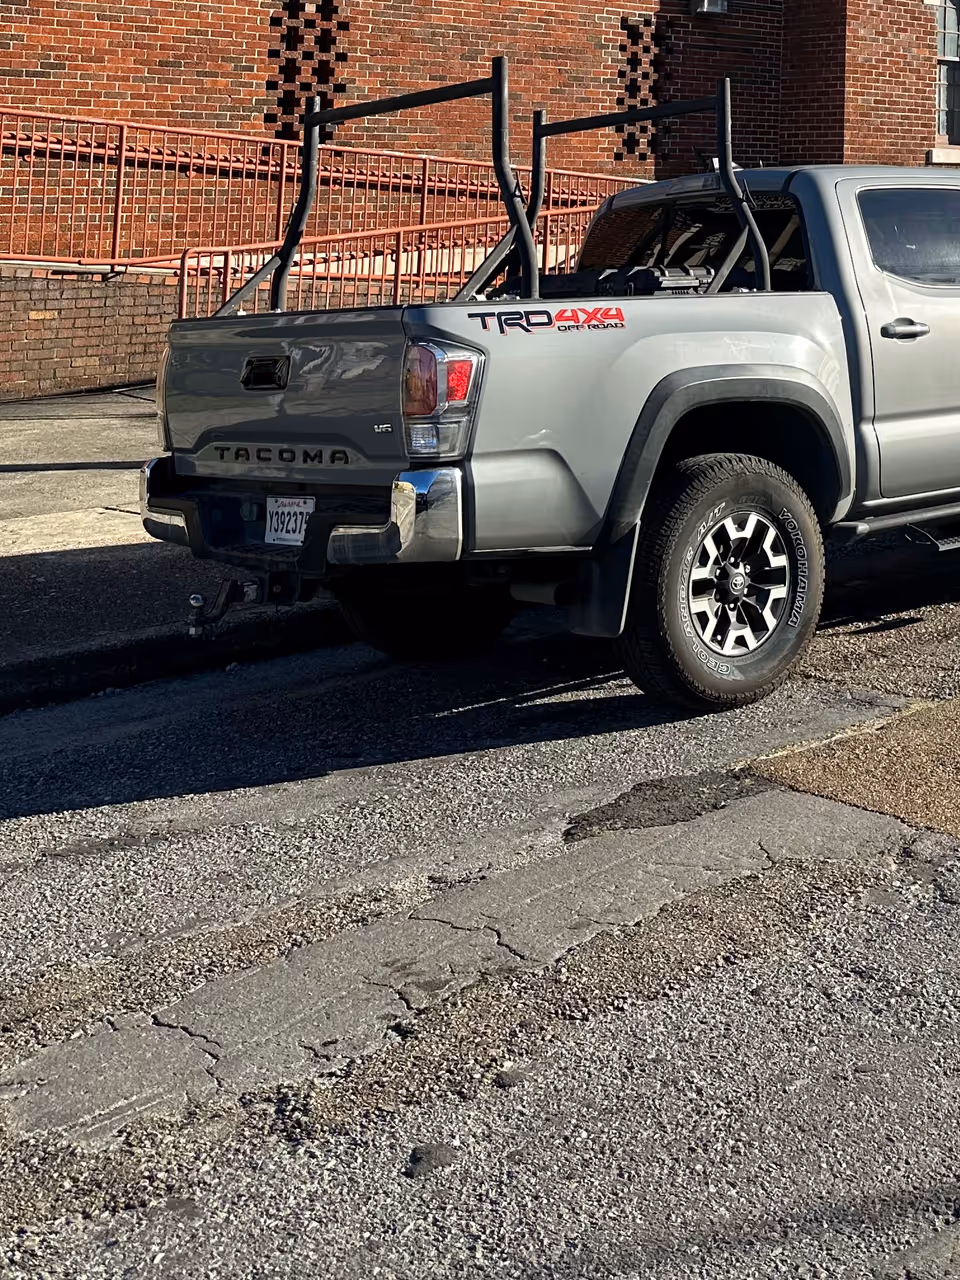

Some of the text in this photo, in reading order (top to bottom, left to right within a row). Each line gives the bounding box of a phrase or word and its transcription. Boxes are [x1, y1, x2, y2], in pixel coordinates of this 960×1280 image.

[467, 307, 625, 336] TRD 4X4
[557, 322, 625, 332] OFF ROAD
[374, 423, 392, 433] V6
[214, 446, 351, 465] TACOMA
[778, 507, 809, 627] YOKOHAMA
